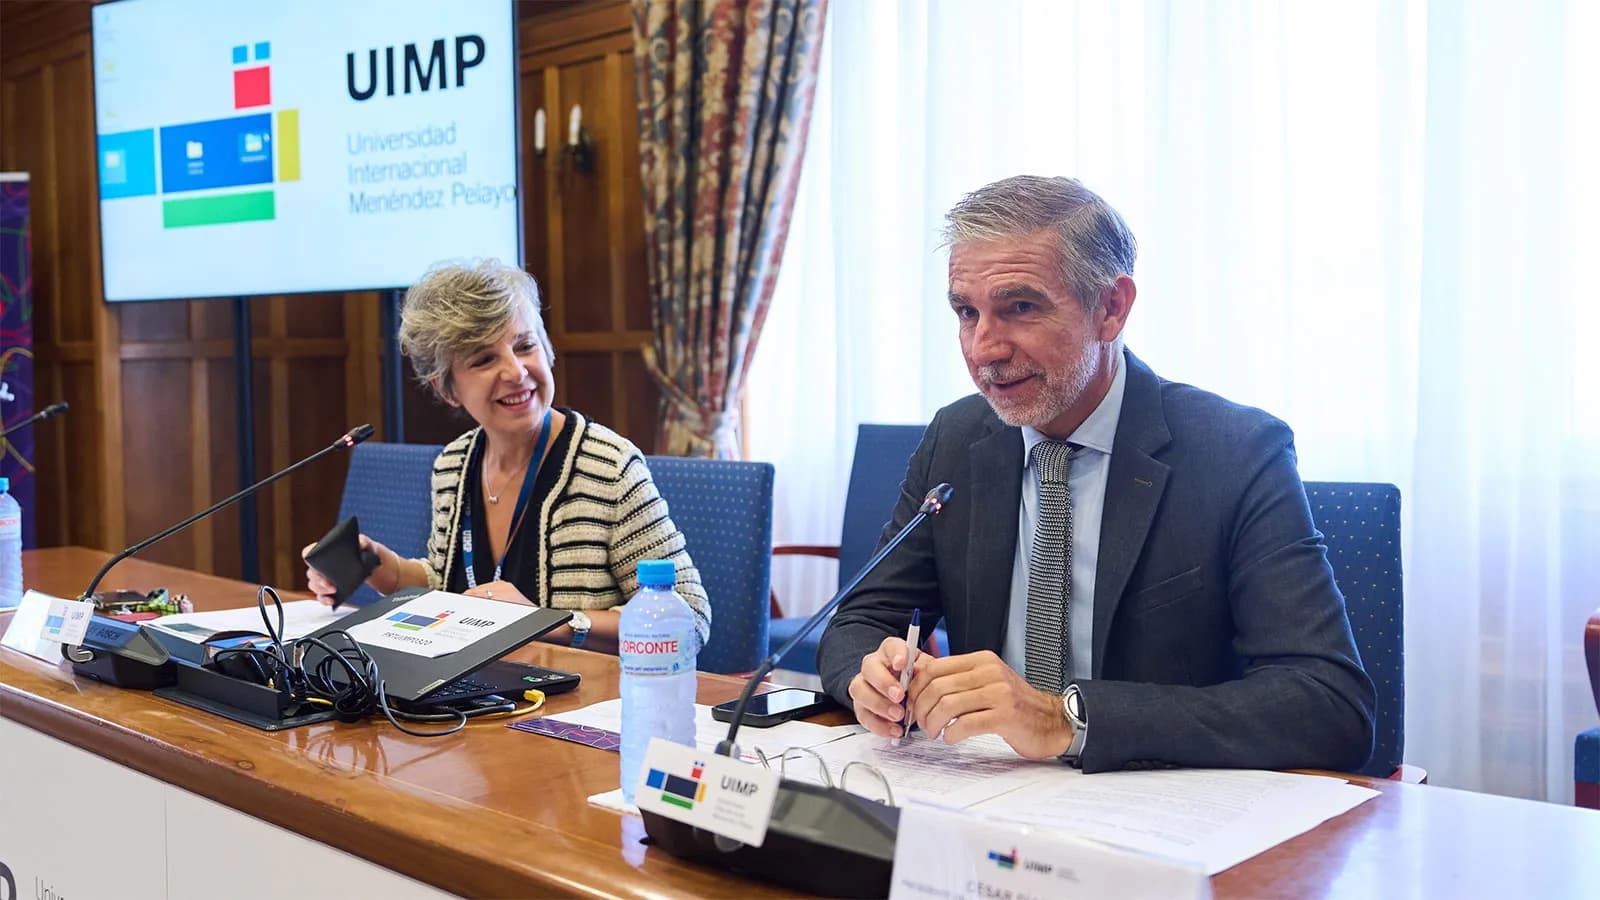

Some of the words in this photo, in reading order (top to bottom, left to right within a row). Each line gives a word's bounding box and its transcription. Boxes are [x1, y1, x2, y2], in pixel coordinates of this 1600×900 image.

[347, 34, 486, 101] UIMP
[347, 121, 457, 155] Universidad
[347, 152, 467, 184] Internacional
[349, 186, 444, 215] Menéndez
[451, 180, 517, 208] Pelayo
[458, 616, 495, 628] UIMP
[621, 639, 678, 655] ORCONTE
[720, 775, 759, 797] UIMP
